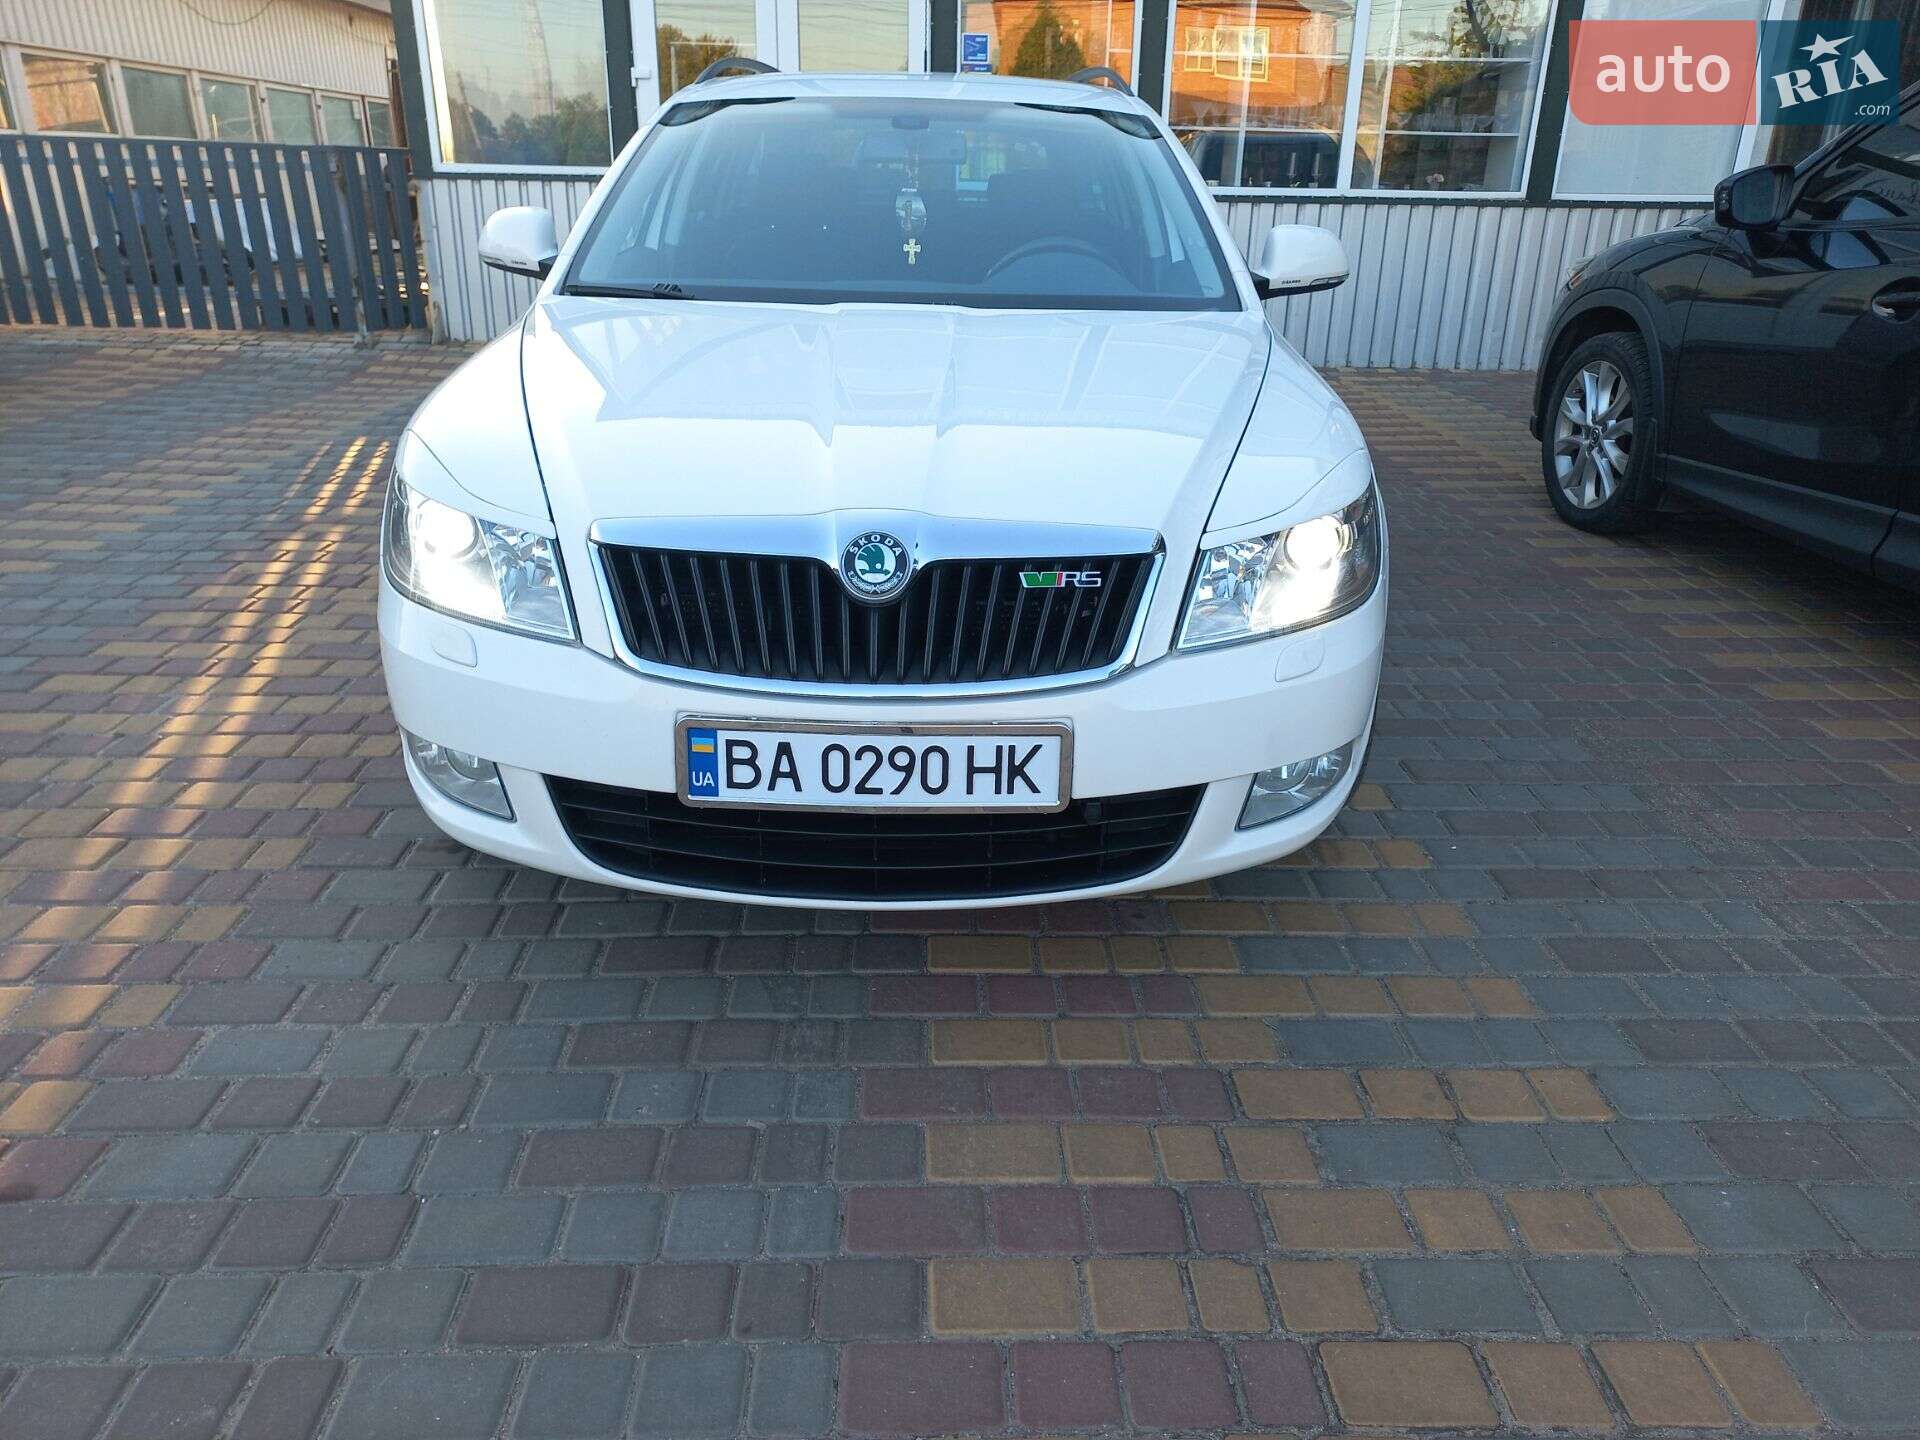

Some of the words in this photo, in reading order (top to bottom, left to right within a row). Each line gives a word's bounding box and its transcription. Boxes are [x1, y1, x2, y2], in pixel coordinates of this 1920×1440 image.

[849, 534, 902, 558] SKODA
[692, 771, 715, 787] UA
[725, 738, 802, 793] BA
[821, 743, 949, 796] 0290
[966, 743, 1043, 795] HK
